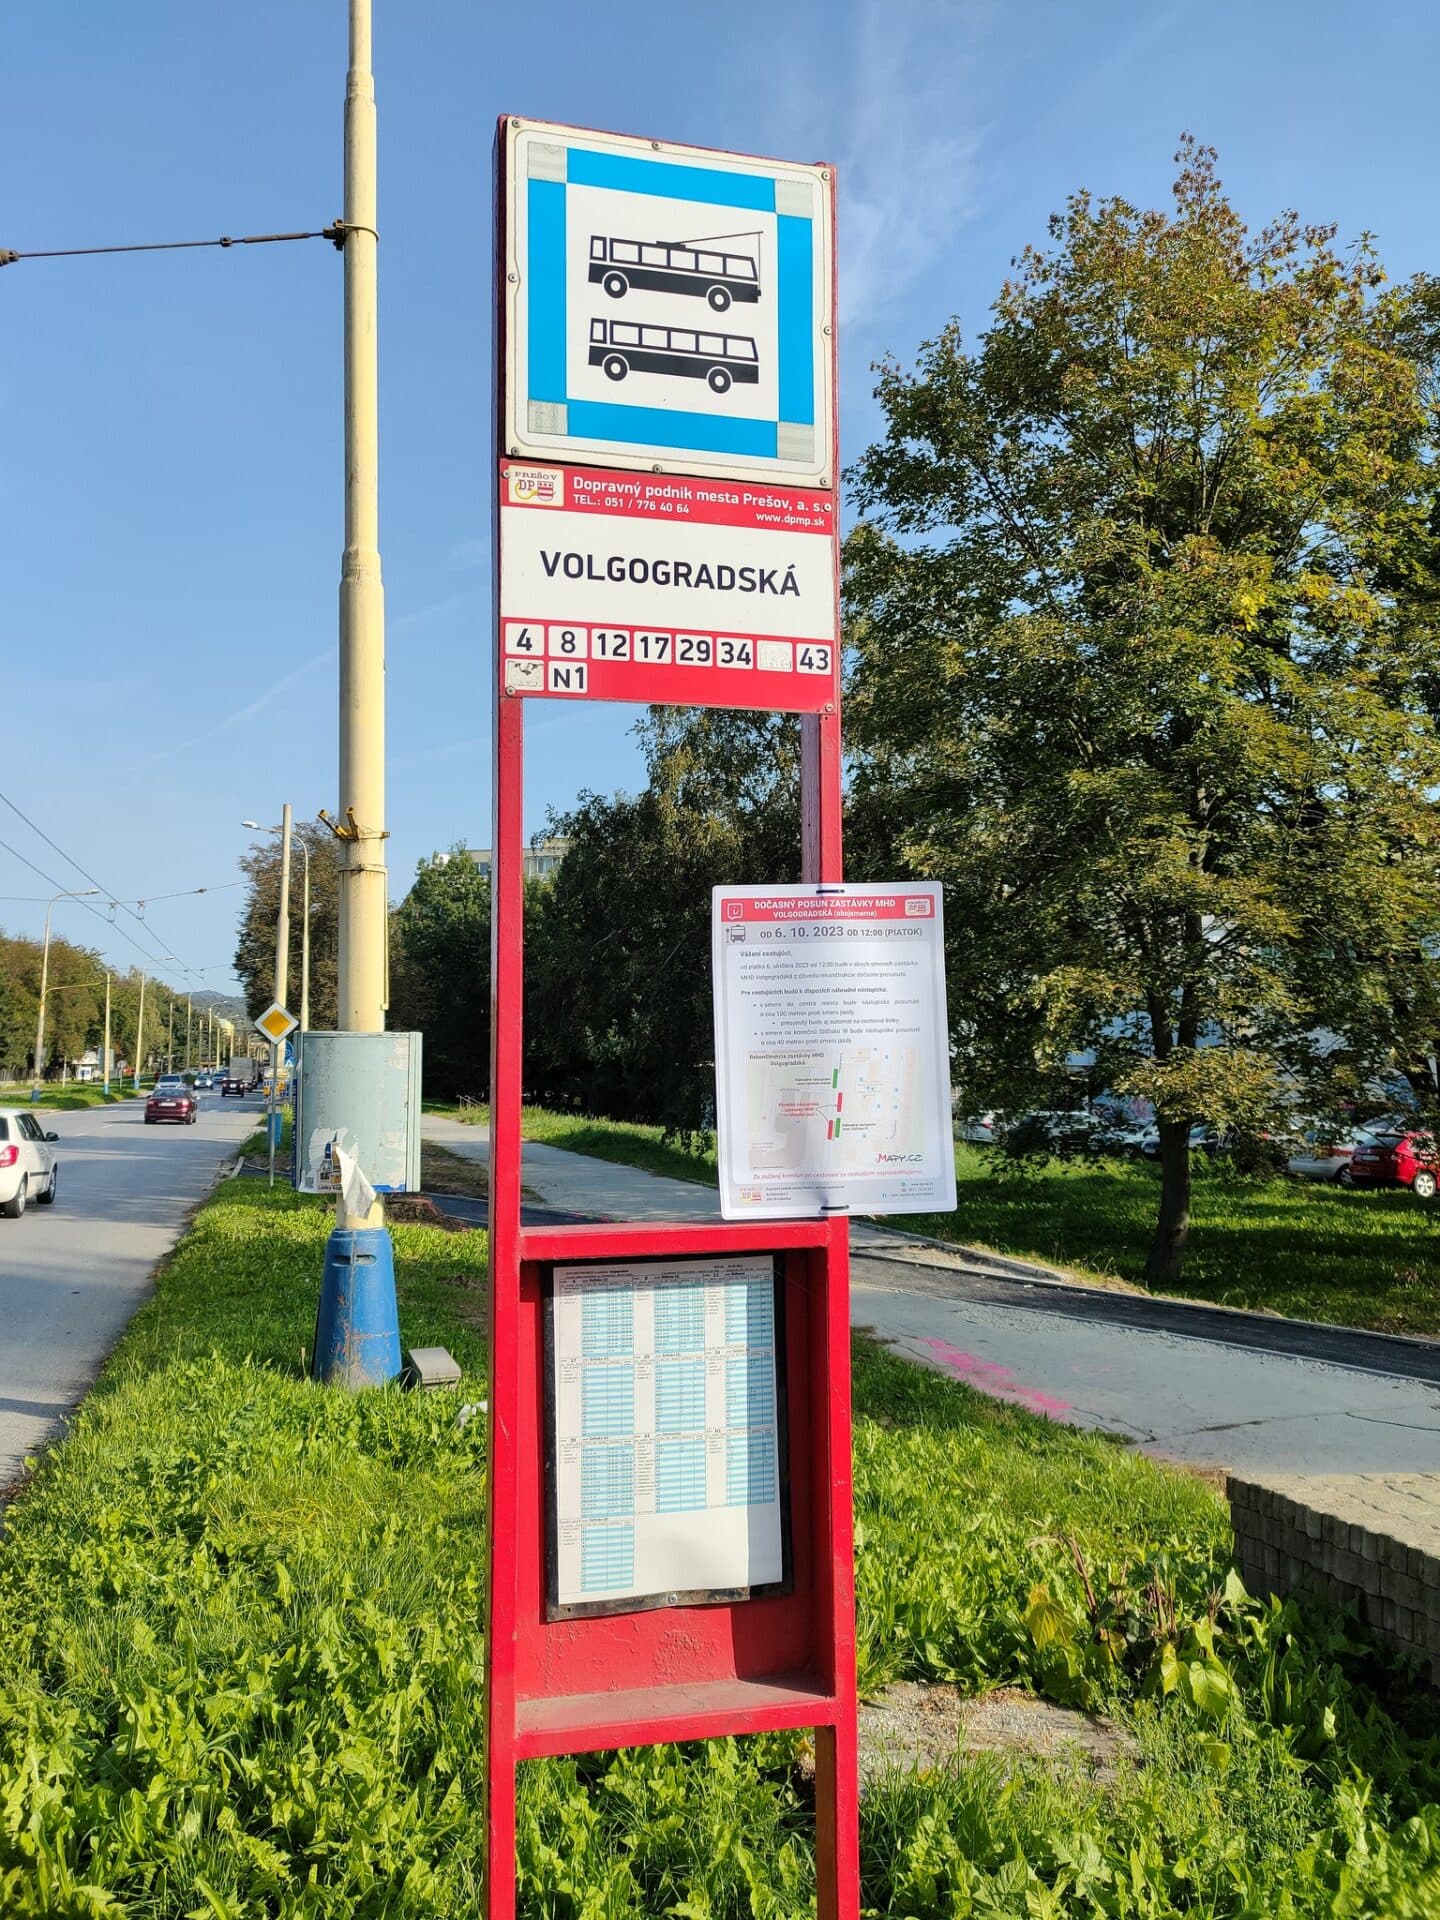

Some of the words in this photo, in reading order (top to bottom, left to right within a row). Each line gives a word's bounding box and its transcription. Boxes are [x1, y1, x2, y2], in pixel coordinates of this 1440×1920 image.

[514, 471, 557, 481] PREŠOV
[518, 480, 535, 491] DP
[573, 476, 641, 497] Dopravný
[645, 487, 693, 501] podnik
[696, 491, 739, 504] mesta
[743, 493, 793, 512] Prešov,
[796, 502, 809, 511] a.
[573, 494, 601, 506] TEL.:
[605, 497, 623, 508] 051
[628, 499, 633, 508] /
[636, 499, 656, 511] 776
[660, 502, 673, 512] 40
[676, 503, 690, 514] 64
[756, 511, 825, 527] www.dpmp.sk
[540, 550, 800, 597] VOLGOGRADSKÁ
[516, 628, 533, 652] 4
[560, 631, 576, 654] 8
[597, 633, 627, 657] 12
[640, 636, 669, 660] 17
[679, 639, 711, 662] 29
[720, 641, 752, 666] 34
[799, 647, 829, 671] 43
[553, 666, 585, 689] N1
[754, 900, 795, 909] DOČASNÝ
[798, 900, 828, 908] POSUN
[830, 898, 873, 908] ZASTÁVKY
[875, 899, 896, 907] MHD
[773, 910, 833, 918] VOLGOGRADSKÁ
[775, 927, 786, 938] 6.
[791, 927, 809, 938] 10.
[813, 926, 844, 937] 2023
[885, 927, 923, 937] (PIATOK)
